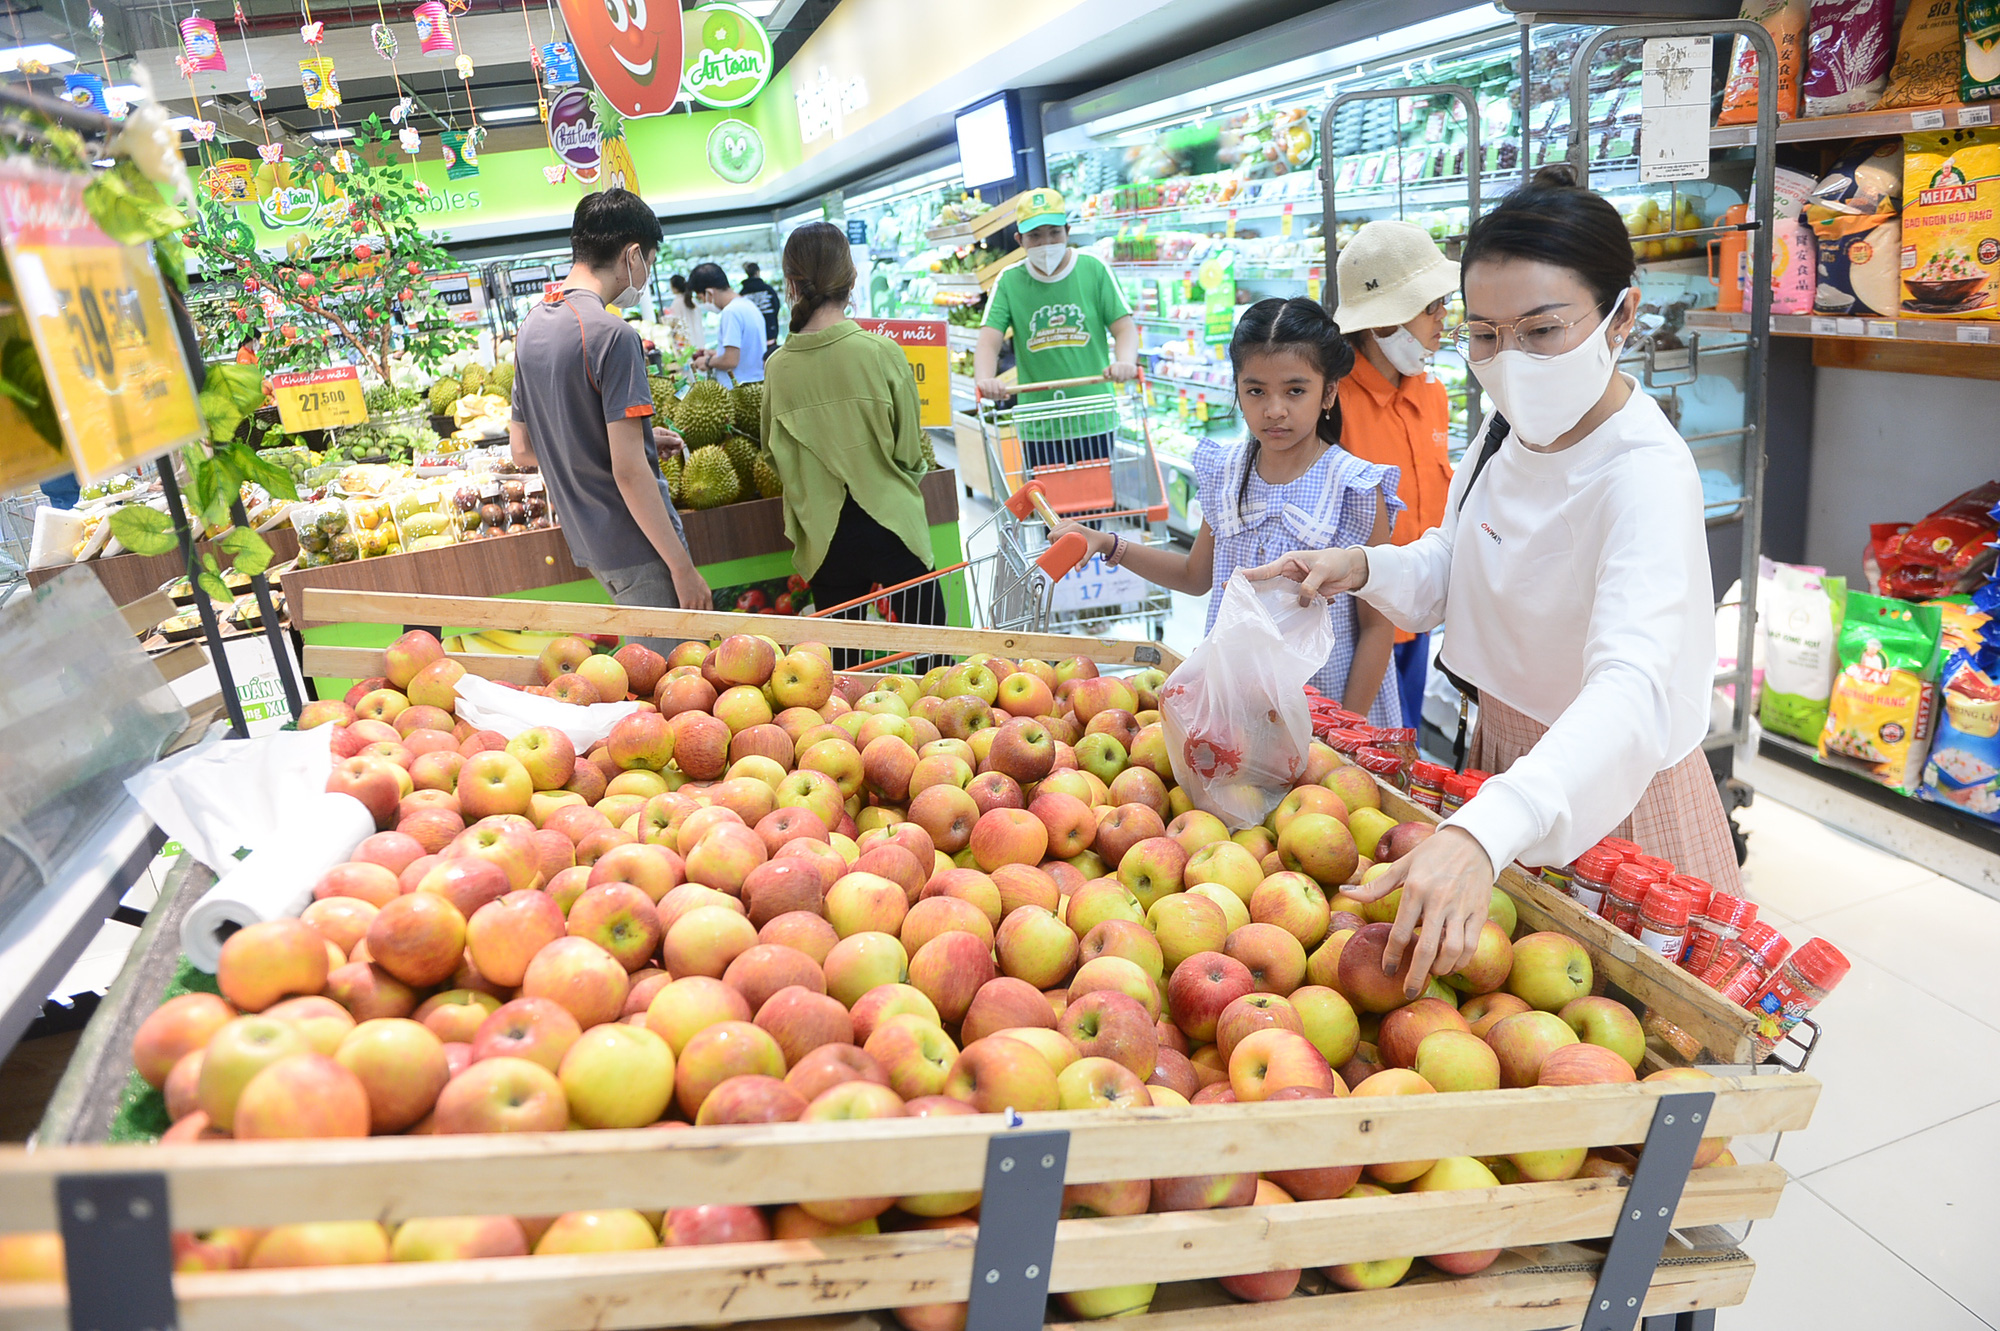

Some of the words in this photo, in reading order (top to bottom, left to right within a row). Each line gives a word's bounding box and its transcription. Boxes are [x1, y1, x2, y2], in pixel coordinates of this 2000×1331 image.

[691, 54, 724, 86] An
[410, 188, 480, 214] ables
[1919, 185, 1977, 206] MEIZAN
[1365, 278, 1379, 291] M
[902, 326, 936, 341] mãi
[298, 389, 346, 412] 27.500
[1080, 583, 1103, 600] 17
